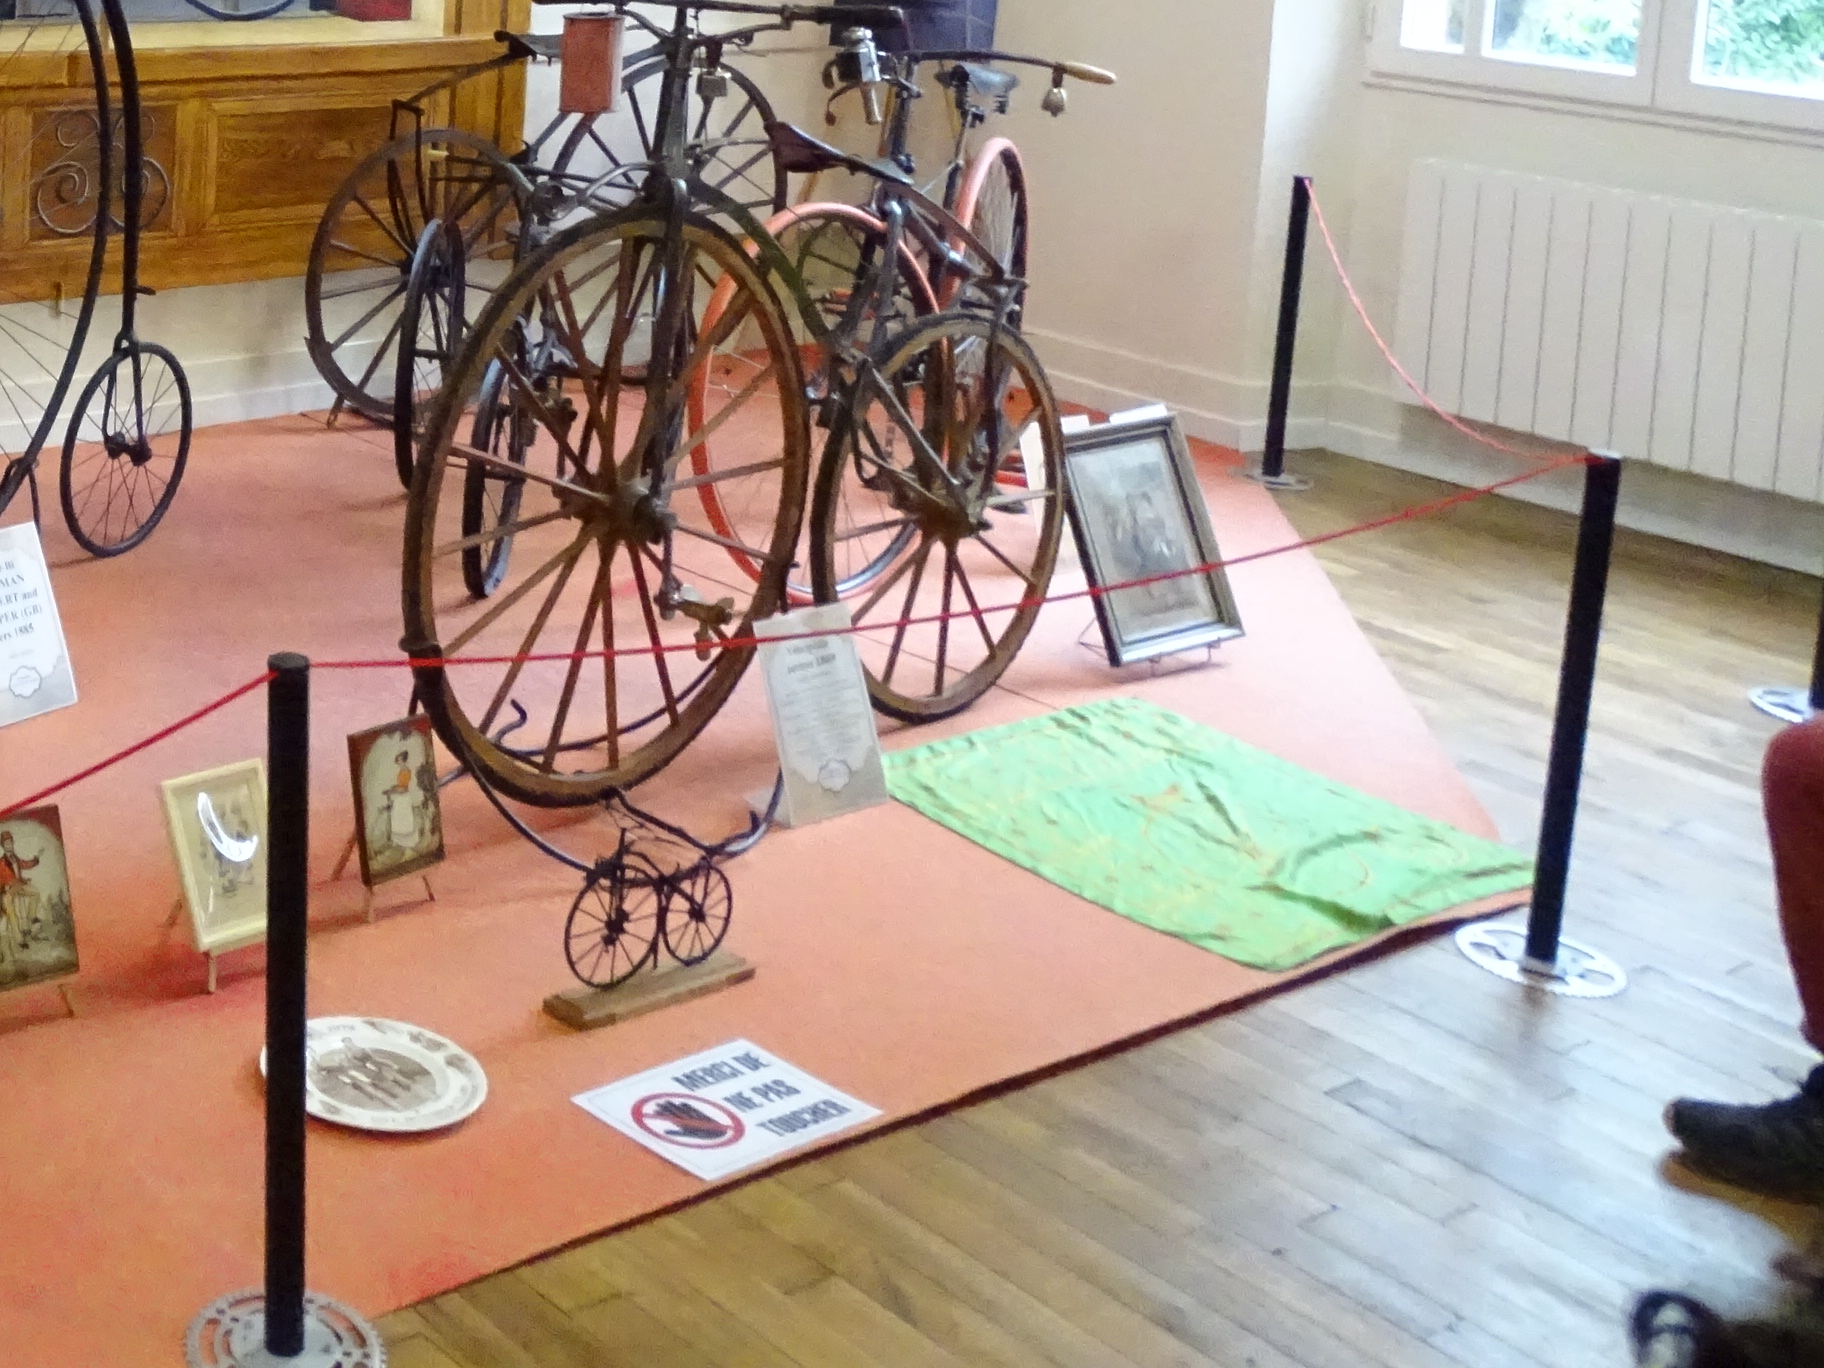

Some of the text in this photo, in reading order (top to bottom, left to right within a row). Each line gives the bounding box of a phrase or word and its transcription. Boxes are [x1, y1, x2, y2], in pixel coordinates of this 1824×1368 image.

[21, 587, 38, 601] and
[671, 1050, 771, 1092] MERCI DE
[723, 1078, 802, 1113] NE PAS
[755, 1098, 852, 1138] TOUCHER
